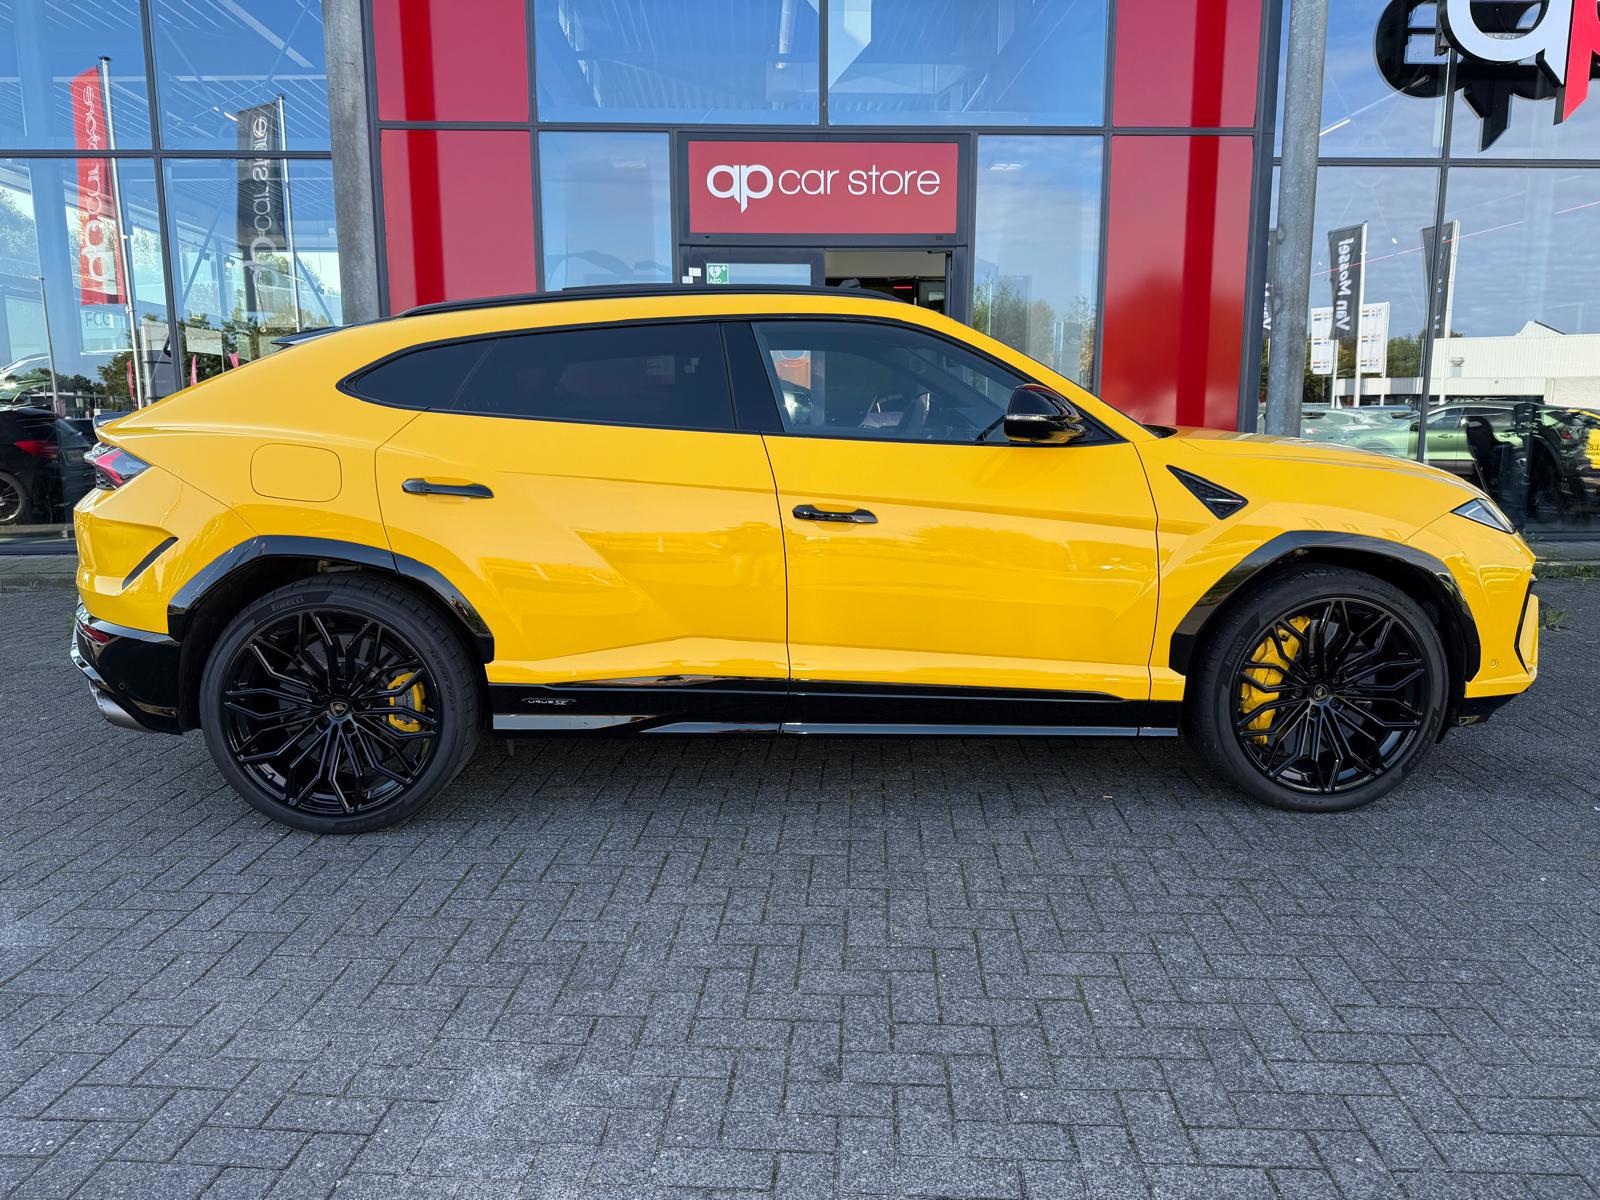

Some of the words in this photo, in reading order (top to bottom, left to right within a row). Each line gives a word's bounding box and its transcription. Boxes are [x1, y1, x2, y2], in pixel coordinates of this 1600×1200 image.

[1446, 0, 1600, 123] a
[706, 164, 774, 214] ap
[778, 169, 840, 195] car
[847, 164, 940, 196] store
[271, 597, 304, 611] PIRELLI
